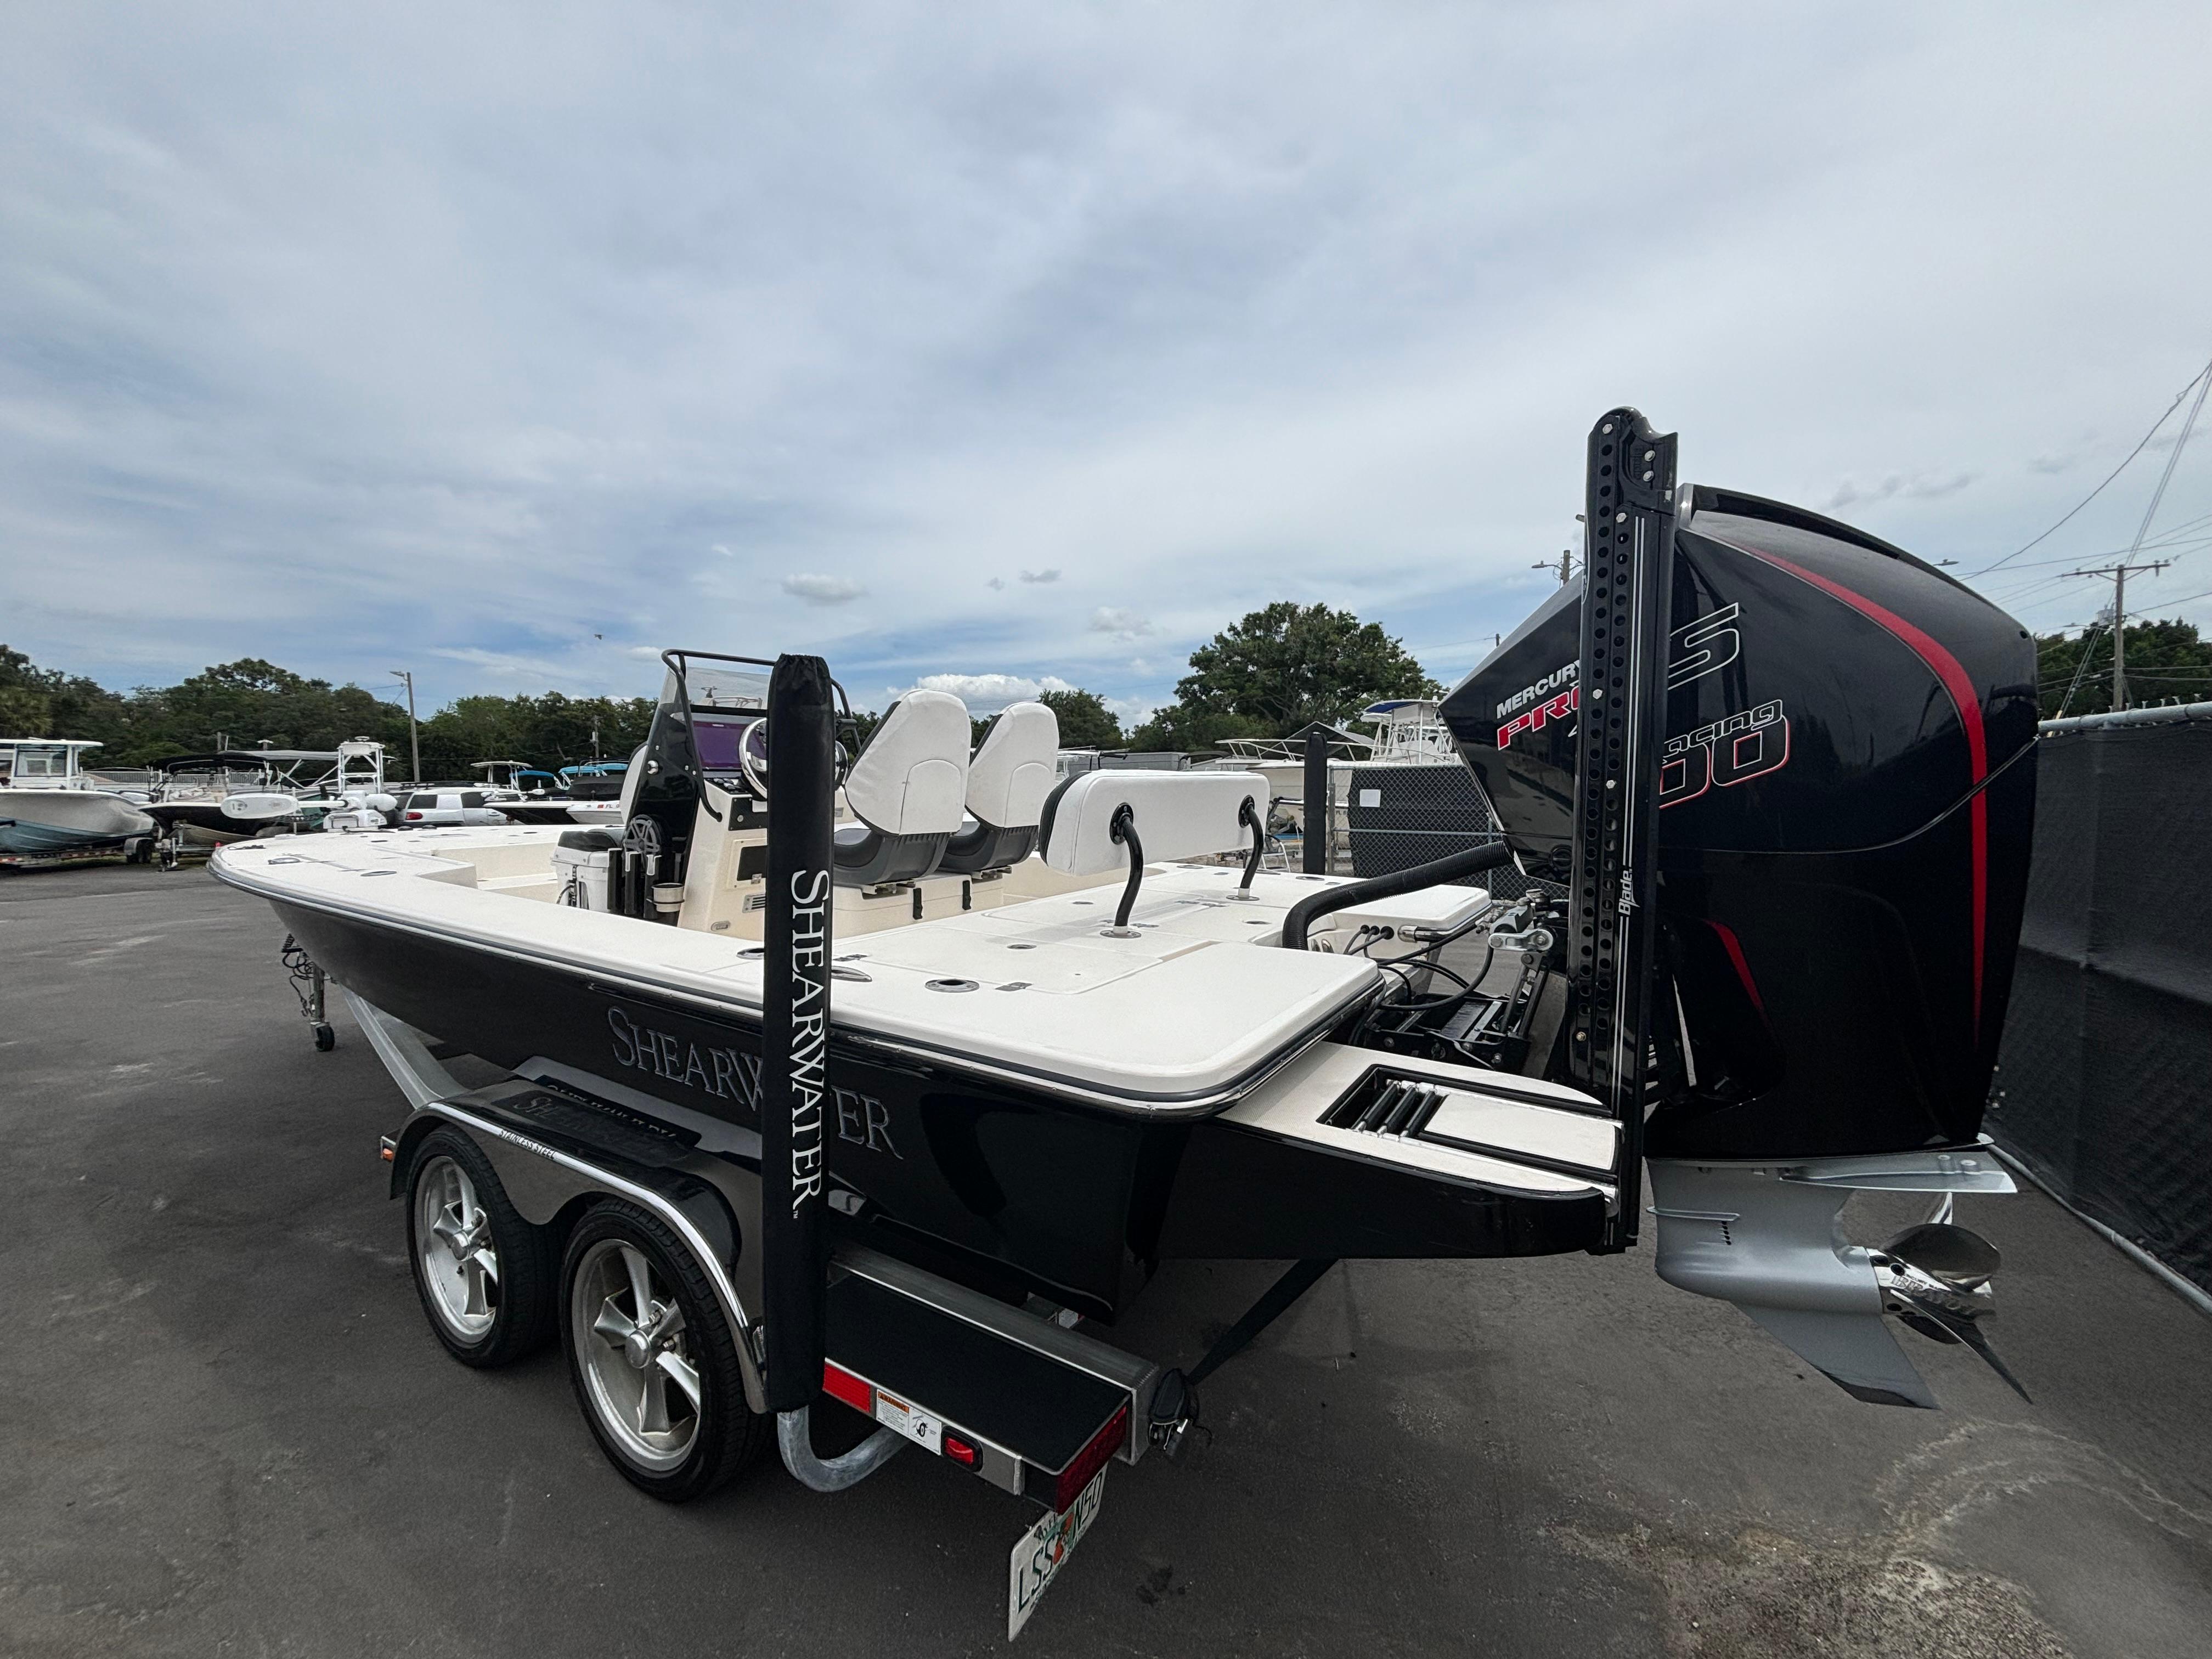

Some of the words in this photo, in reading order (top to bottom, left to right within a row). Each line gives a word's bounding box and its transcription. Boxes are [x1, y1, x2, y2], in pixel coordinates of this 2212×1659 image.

[1662, 699, 1782, 758] acing
[1659, 714, 1790, 809] 00
[1618, 870, 1640, 915] Blade
[607, 1005, 904, 1160] SHEARWER
[534, 1143, 556, 1159] STEEL
